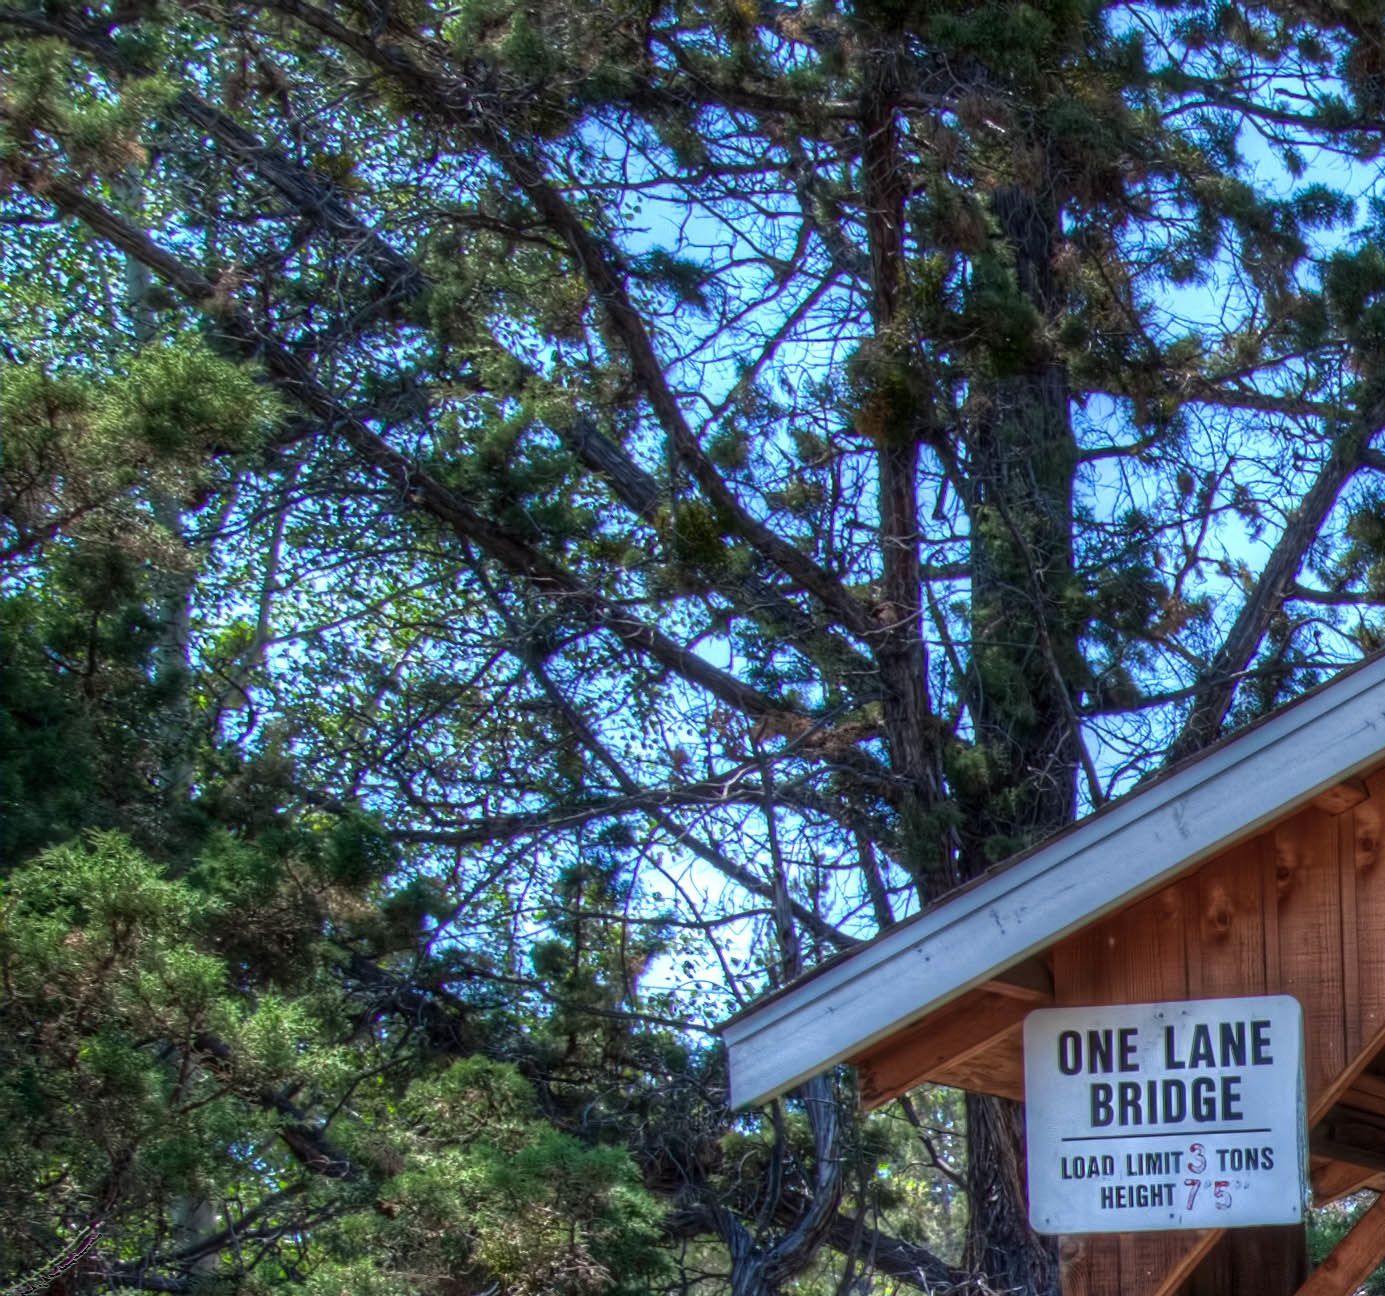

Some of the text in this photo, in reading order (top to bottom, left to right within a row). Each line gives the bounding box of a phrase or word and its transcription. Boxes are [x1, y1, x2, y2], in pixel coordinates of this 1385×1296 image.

[1059, 1020, 1274, 1076] ONE LANE
[1090, 1076, 1244, 1128] BRIDGE
[1061, 1143, 1275, 1180] LOAD LIMIT 3 TONS
[1100, 1183, 1176, 1209] HEIGHT
